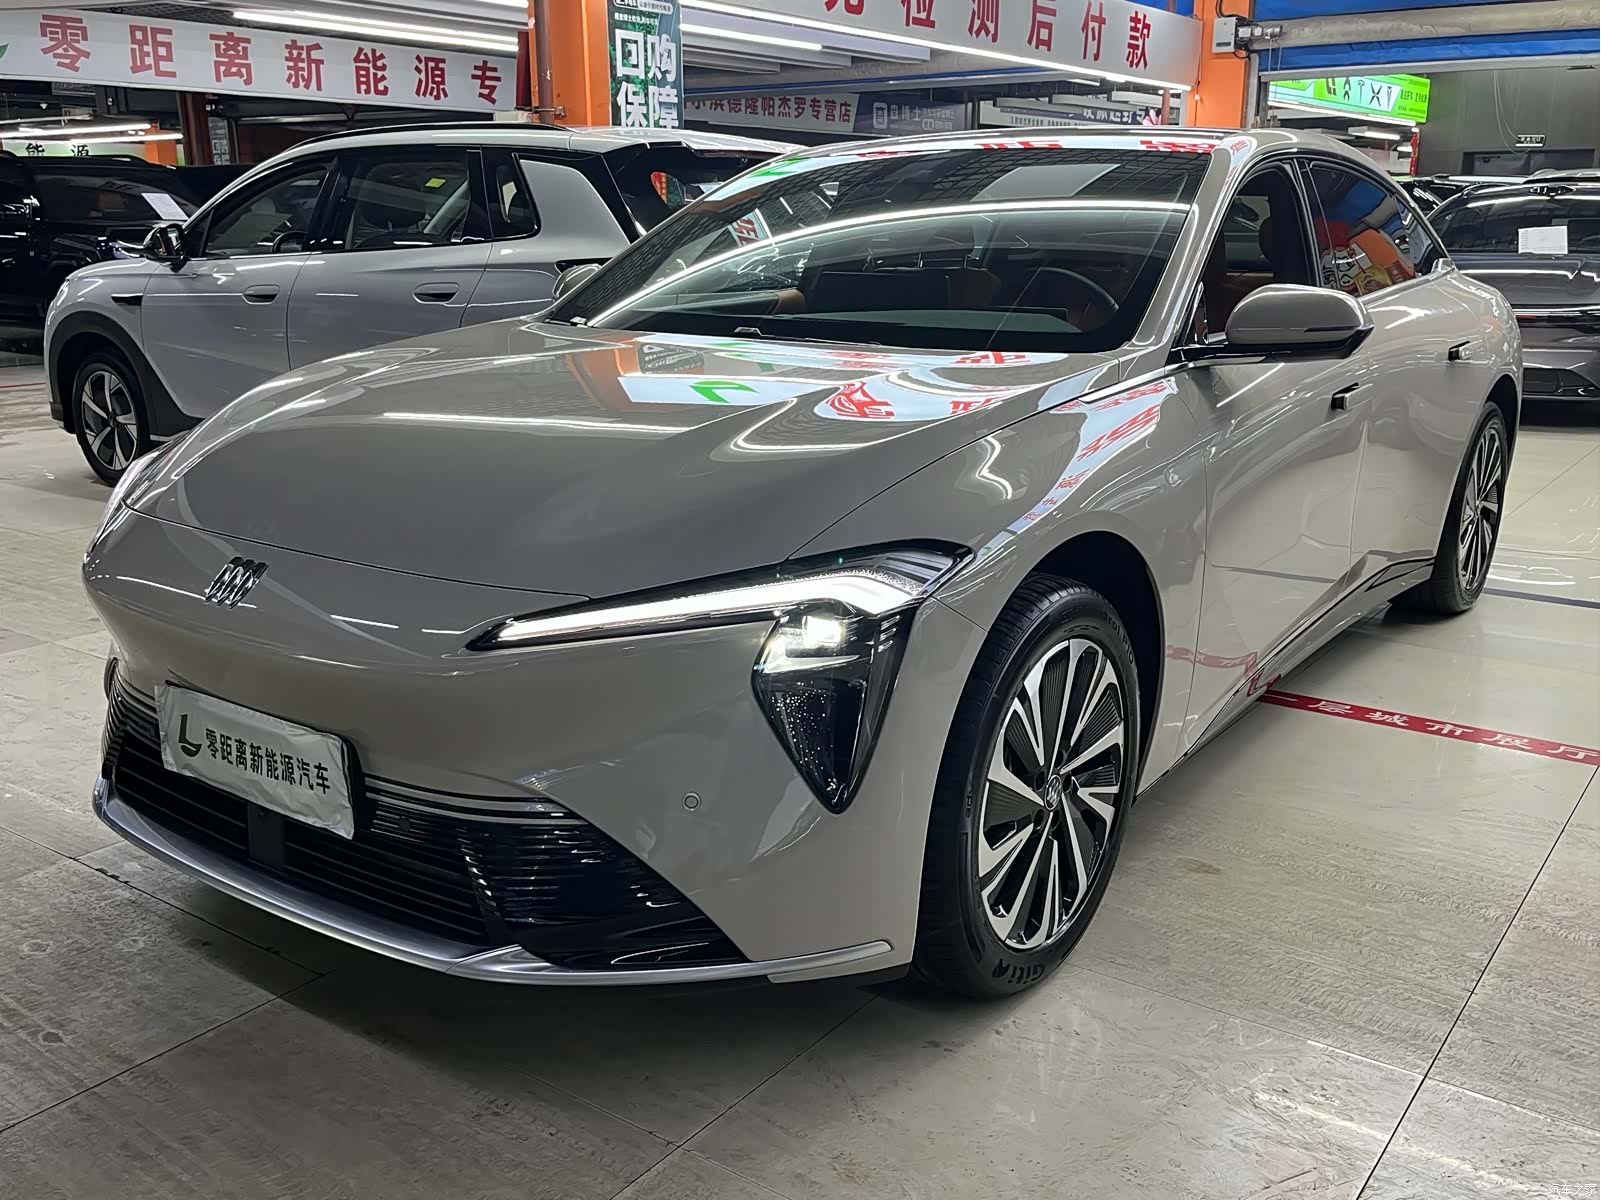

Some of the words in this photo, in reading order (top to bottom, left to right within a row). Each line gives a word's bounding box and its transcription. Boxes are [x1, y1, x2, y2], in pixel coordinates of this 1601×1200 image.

[39, 14, 502, 105] 零距离新能源专
[614, 28, 677, 82] 回购
[826, 0, 1152, 69] 测后付款
[616, 80, 679, 129] 保障
[684, 96, 851, 123] 滨德隆帕杰罗专营店
[1264, 693, 1600, 760] 一层城市展厅
[205, 727, 331, 795] 零距离新能源汽车
